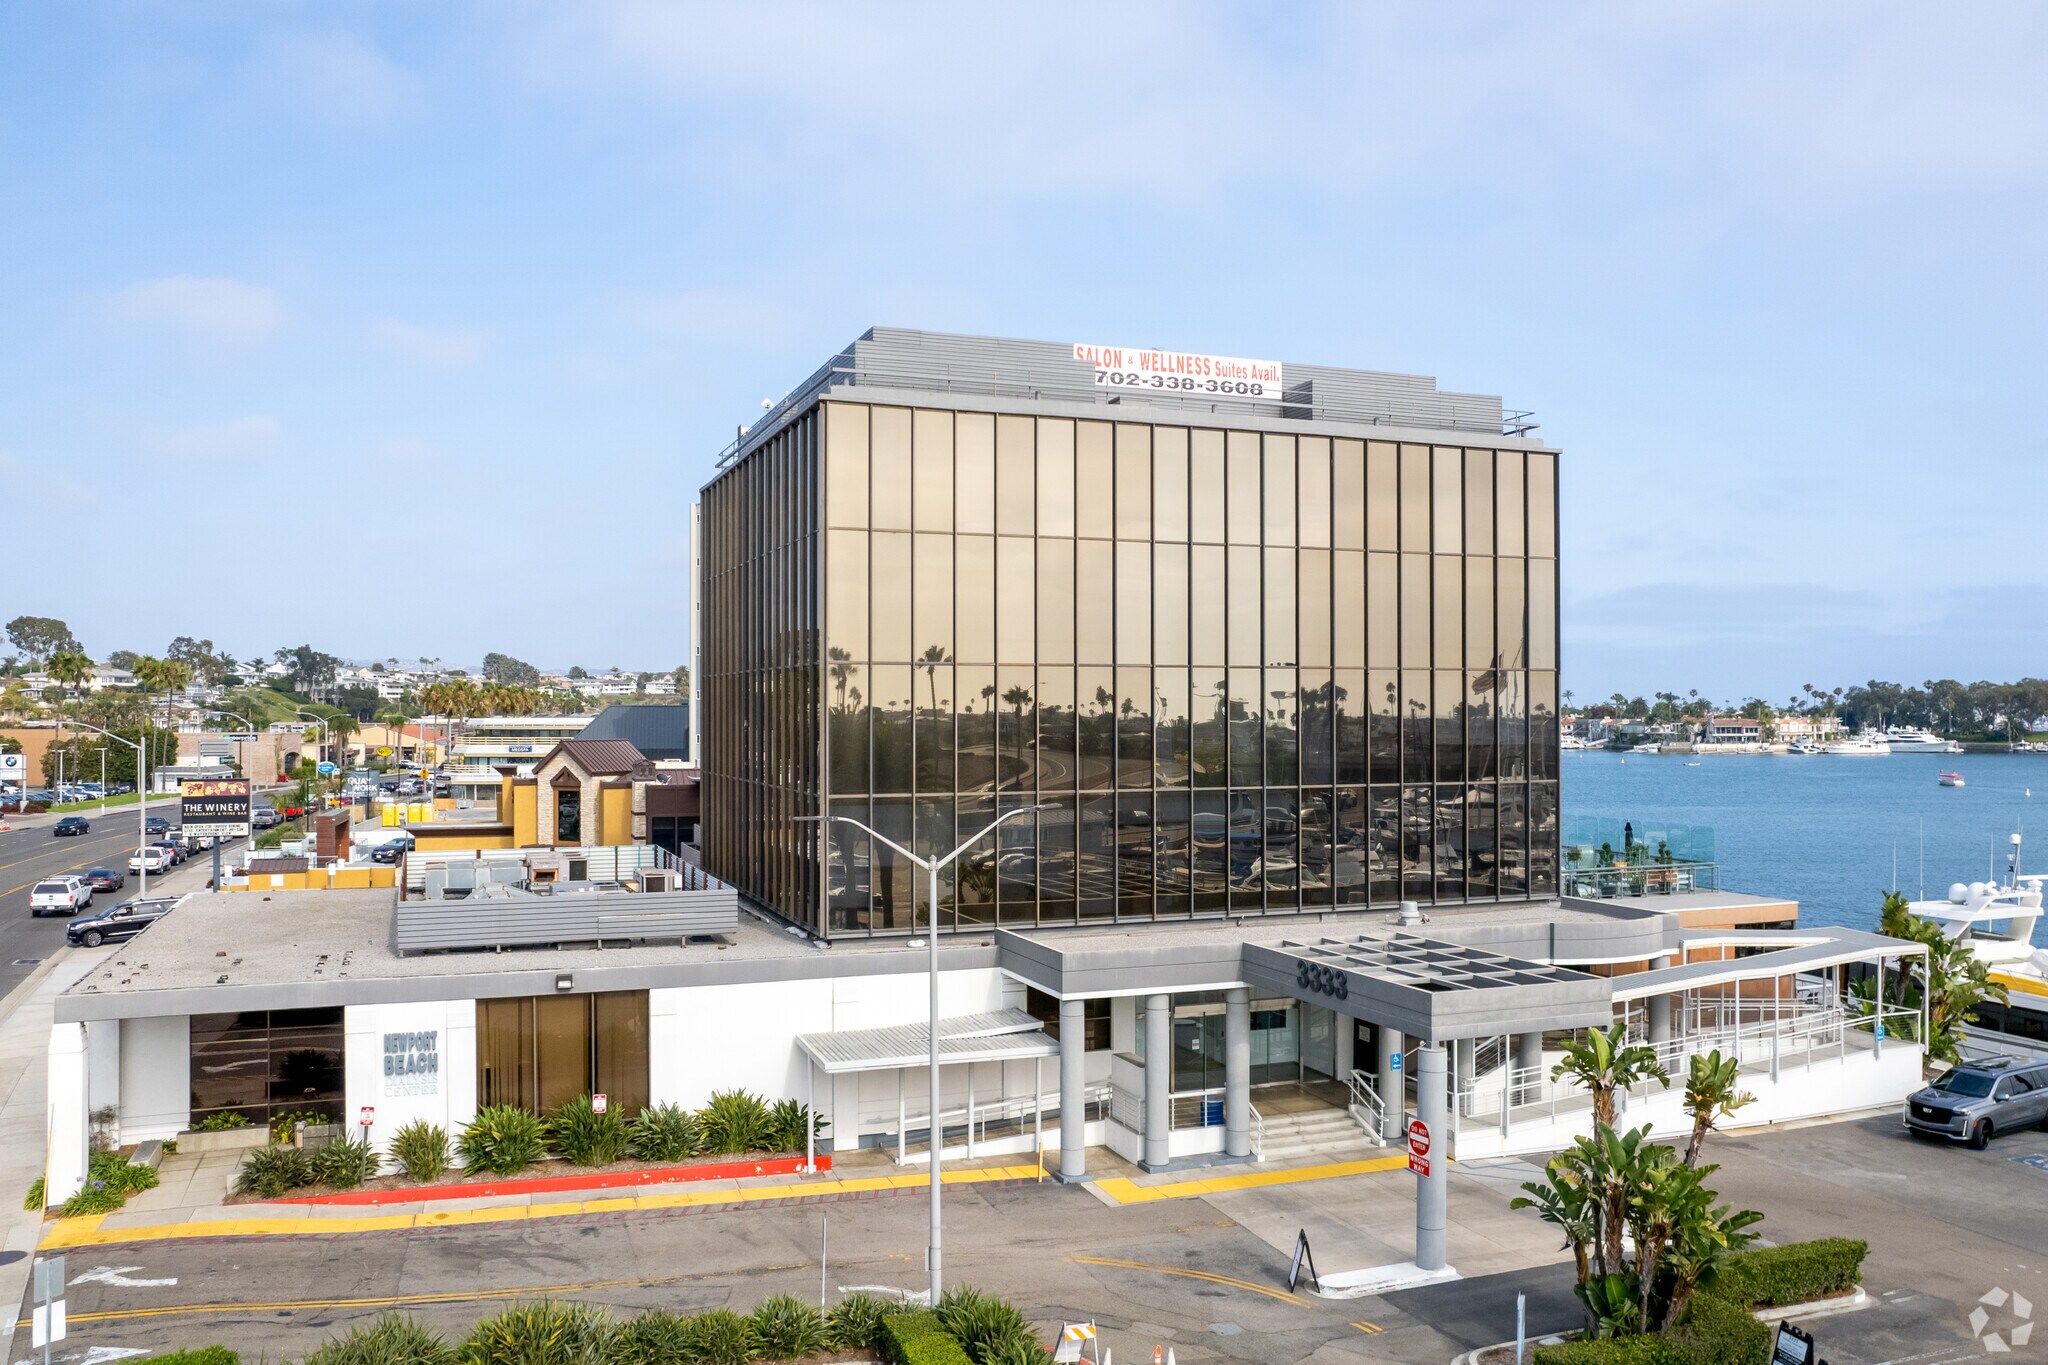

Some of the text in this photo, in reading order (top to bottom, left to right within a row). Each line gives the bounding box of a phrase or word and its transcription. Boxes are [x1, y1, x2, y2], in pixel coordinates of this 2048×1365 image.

[1076, 346, 1280, 382] SALON & WELLNESS Suites Avail.
[1095, 370, 1263, 395] 702-338-3608
[347, 776, 372, 785] QUAY
[183, 803, 247, 812] THE WINERY
[1296, 960, 1348, 1000] 3333
[384, 1030, 438, 1053] NEWPORT
[384, 1053, 438, 1076] BEACH
[385, 1085, 438, 1098] CENTER
[1418, 1128, 1428, 1136] NOT
[1412, 1140, 1426, 1151] ENTER
[1410, 1154, 1429, 1168] WRONG
[1413, 1163, 1425, 1173] WAY
